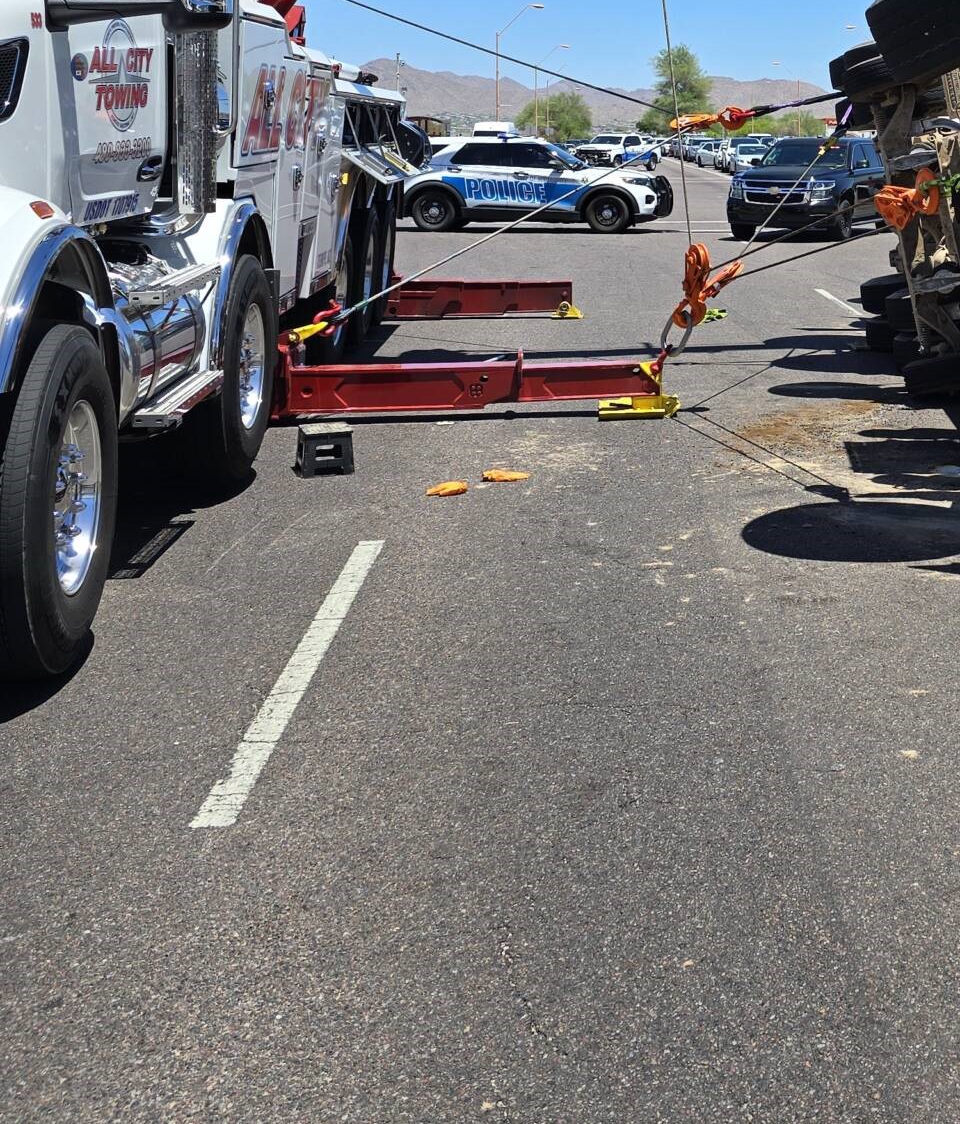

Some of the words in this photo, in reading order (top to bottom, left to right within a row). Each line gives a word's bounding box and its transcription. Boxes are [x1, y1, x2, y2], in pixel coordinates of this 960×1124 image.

[89, 46, 118, 73] ALL
[125, 47, 153, 72] CITY
[95, 83, 148, 111] TOWING
[240, 63, 287, 156] ALL
[464, 177, 548, 204] POLICE
[83, 199, 113, 222] USDOT
